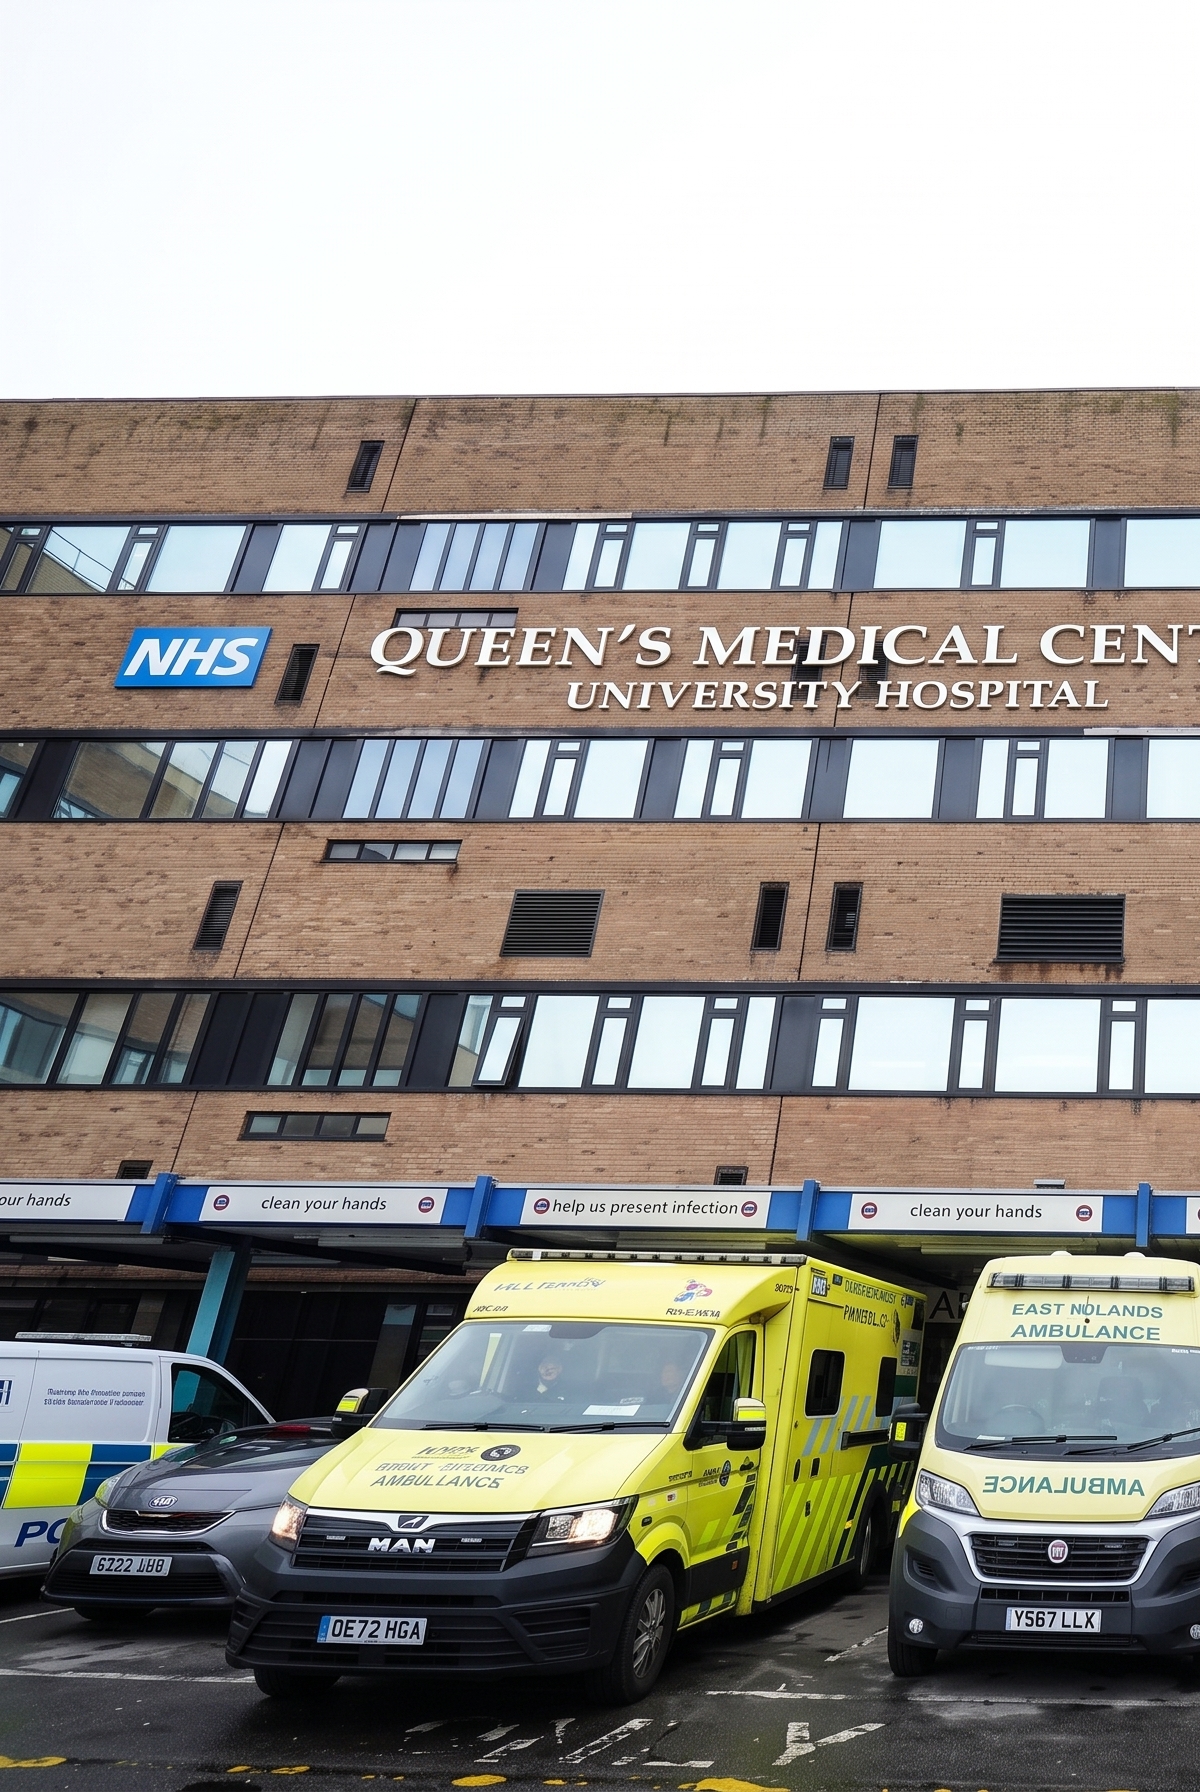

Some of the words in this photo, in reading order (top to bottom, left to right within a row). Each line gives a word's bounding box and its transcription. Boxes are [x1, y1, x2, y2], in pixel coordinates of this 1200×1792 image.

[123, 637, 259, 676] NHS
[370, 624, 673, 676] QUEEN'S
[692, 625, 1018, 667] MEDICAL
[567, 681, 862, 710] UNIVERSITY
[875, 680, 1109, 709] HOSPITAL
[0, 1196, 25, 1206] our
[26, 1193, 72, 1207] hands
[261, 1195, 301, 1210] clean
[303, 1199, 338, 1214] your
[341, 1196, 387, 1211] hands
[552, 1198, 586, 1217] help
[589, 1203, 606, 1213] us
[609, 1201, 669, 1217] present
[672, 1199, 738, 1215] infection
[910, 1203, 951, 1218] clean
[955, 1207, 991, 1221] your
[995, 1203, 1042, 1219] hands
[1012, 1303, 1065, 1316] EAST
[1010, 1325, 1161, 1341] AMBULANCE
[368, 1537, 436, 1554] MAN
[1061, 1612, 1096, 1629] LLX
[384, 1620, 421, 1640] HGA
